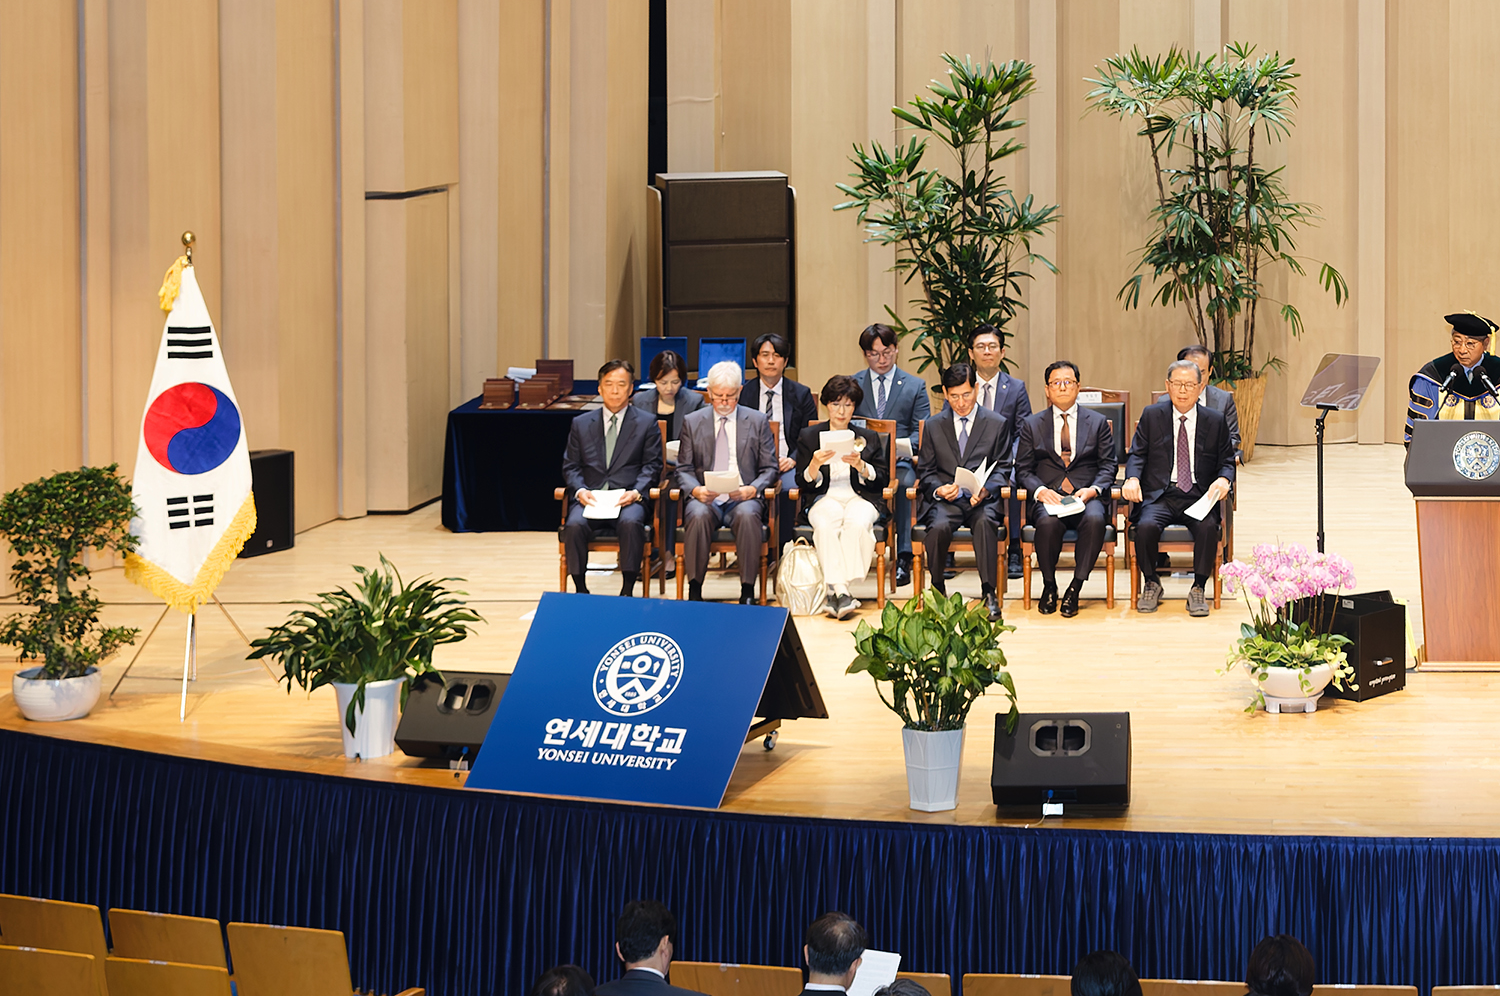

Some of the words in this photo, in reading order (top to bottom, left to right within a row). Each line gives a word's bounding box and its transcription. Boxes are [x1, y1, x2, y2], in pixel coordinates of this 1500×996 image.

[600, 638, 636, 672] YONSEI
[640, 635, 680, 678] UNIVERSITY
[543, 717, 688, 754] 연세대학교
[537, 747, 589, 764] YONSEI
[591, 752, 677, 771] UNIVERSITY
